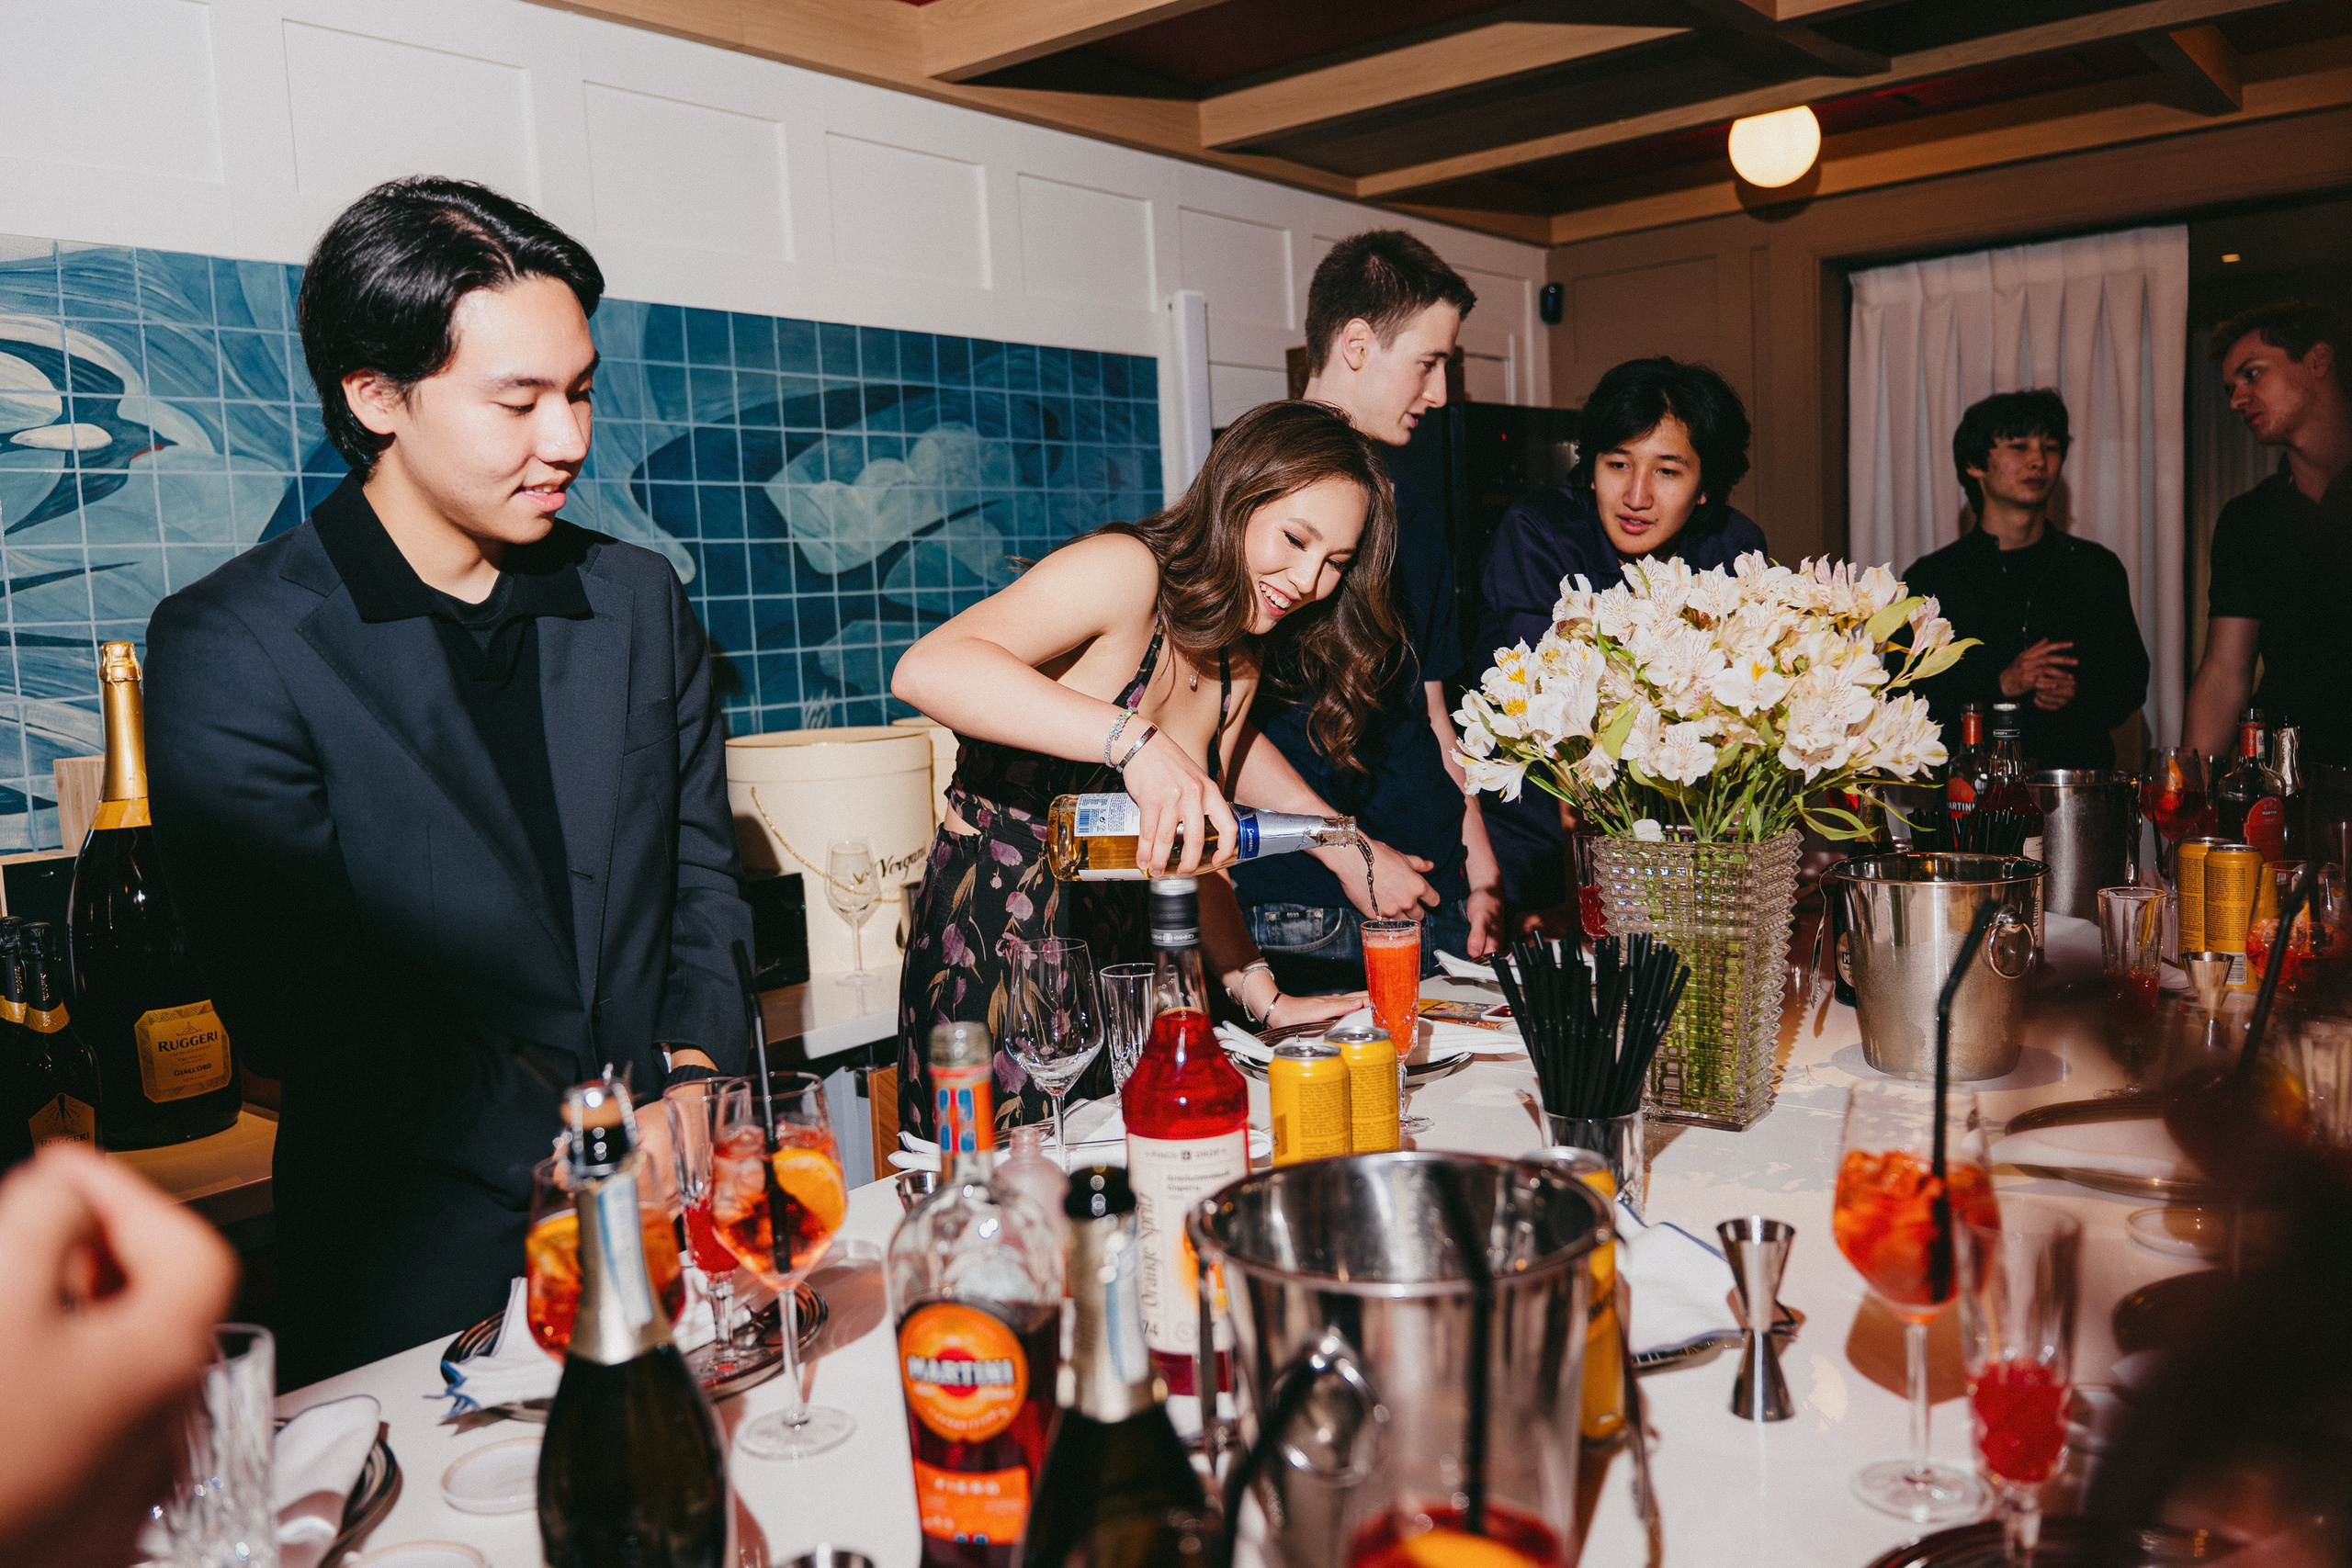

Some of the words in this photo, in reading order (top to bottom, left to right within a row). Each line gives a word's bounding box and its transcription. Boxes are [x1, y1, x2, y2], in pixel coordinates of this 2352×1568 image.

[1947, 801, 1975, 812] ARTINI
[157, 1030, 218, 1053] RUGGERI
[40, 1132, 90, 1148] RUGGERI
